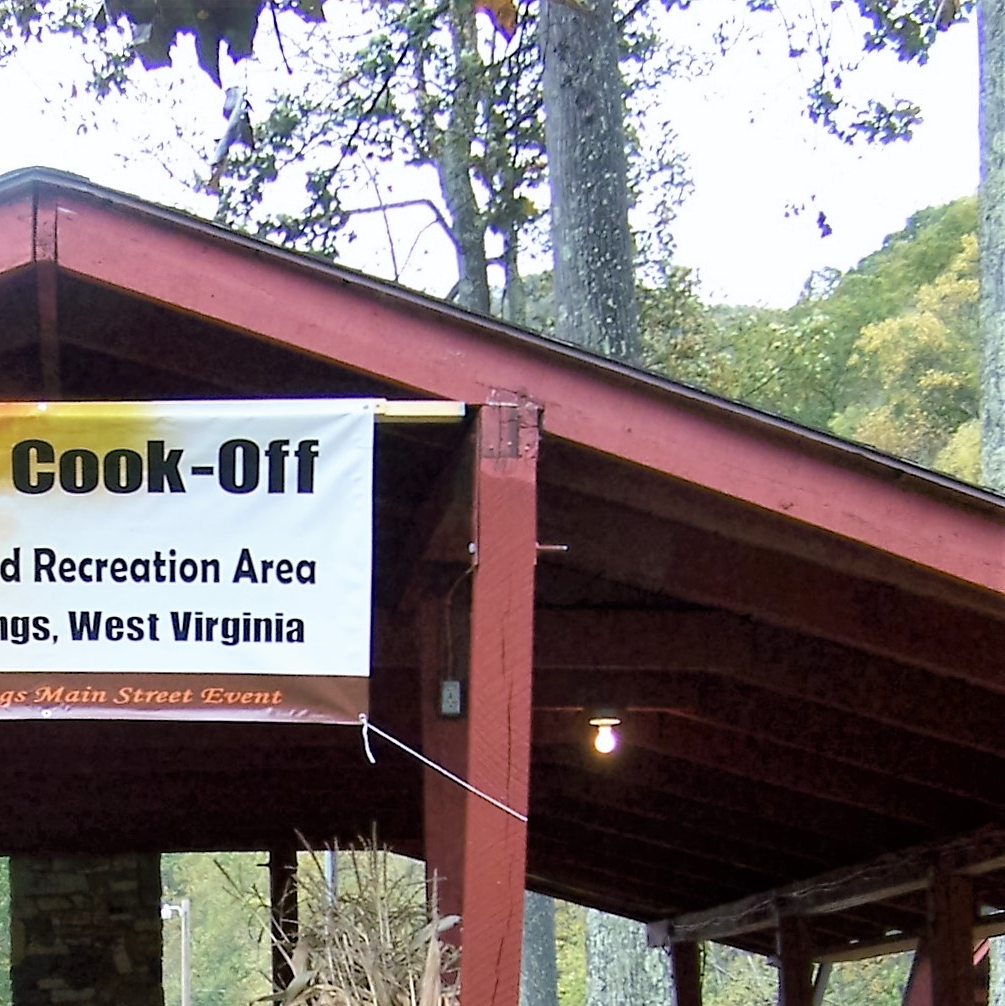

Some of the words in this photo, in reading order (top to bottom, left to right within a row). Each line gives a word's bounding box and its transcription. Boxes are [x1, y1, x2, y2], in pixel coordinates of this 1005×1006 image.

[11, 438, 319, 495] Cook-Off
[32, 547, 221, 583] Recreation
[232, 548, 317, 584] Area
[68, 610, 161, 642] West
[170, 611, 305, 645] Virginia
[32, 686, 106, 704] Main
[113, 686, 193, 705] Street
[200, 687, 283, 705] Event
